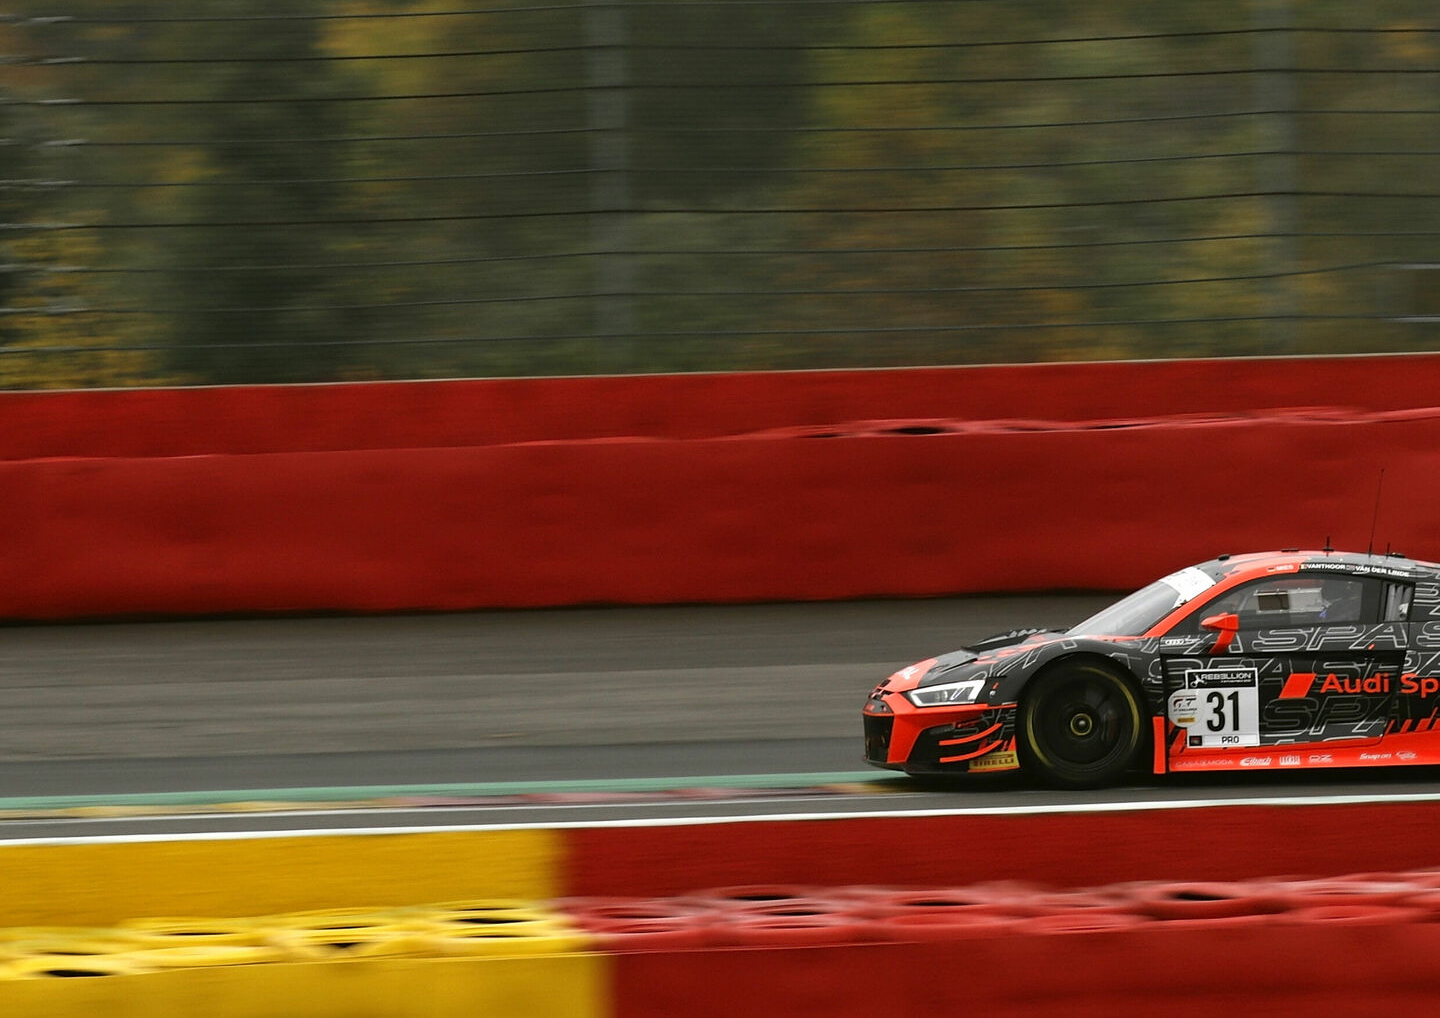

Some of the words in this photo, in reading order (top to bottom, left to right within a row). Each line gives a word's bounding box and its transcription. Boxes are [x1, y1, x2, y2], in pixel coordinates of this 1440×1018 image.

[1252, 623, 1408, 652] SPA
[1320, 673, 1390, 694] Audi
[1206, 690, 1240, 732] 31
[1221, 735, 1240, 744] PRO
